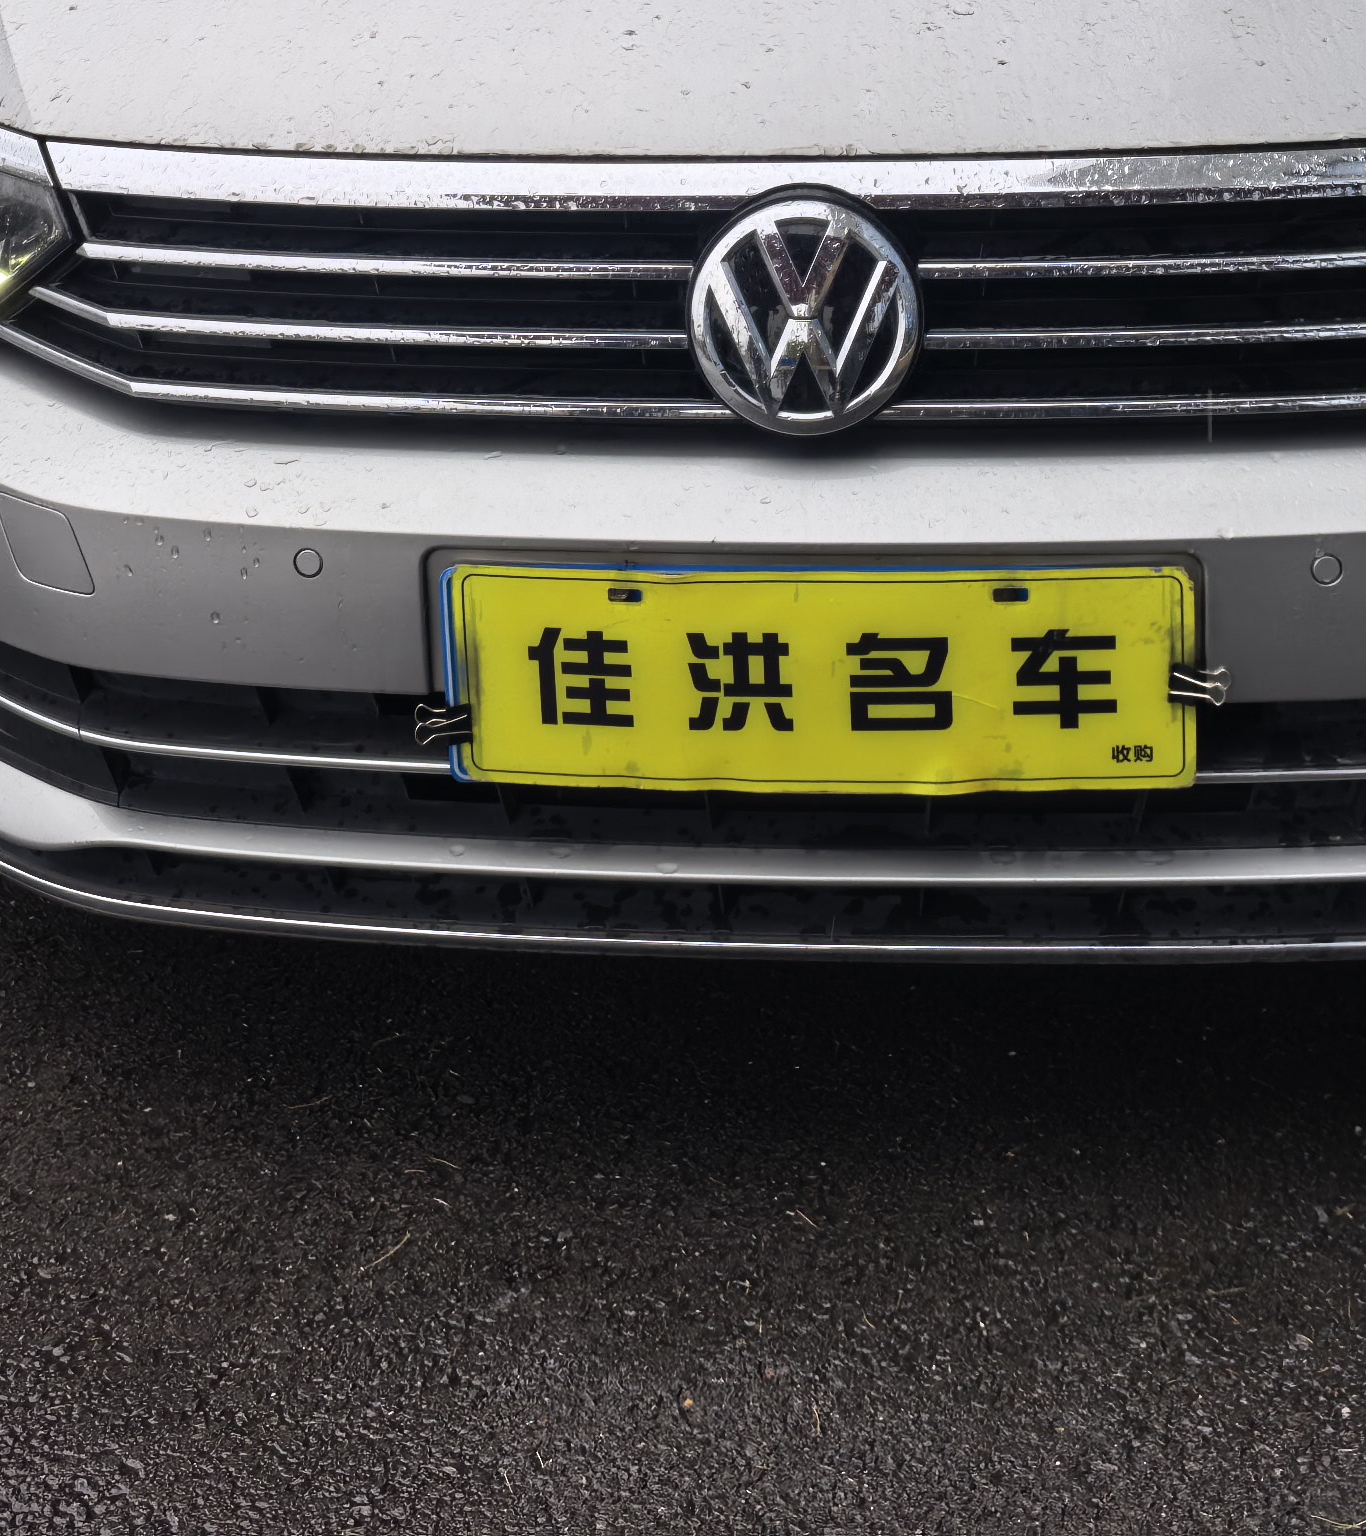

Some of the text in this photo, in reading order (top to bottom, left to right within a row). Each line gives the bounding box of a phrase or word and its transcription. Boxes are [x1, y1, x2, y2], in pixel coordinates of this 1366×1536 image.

[527, 626, 1119, 733] 佳洪名车
[1110, 744, 1154, 763] 收购
